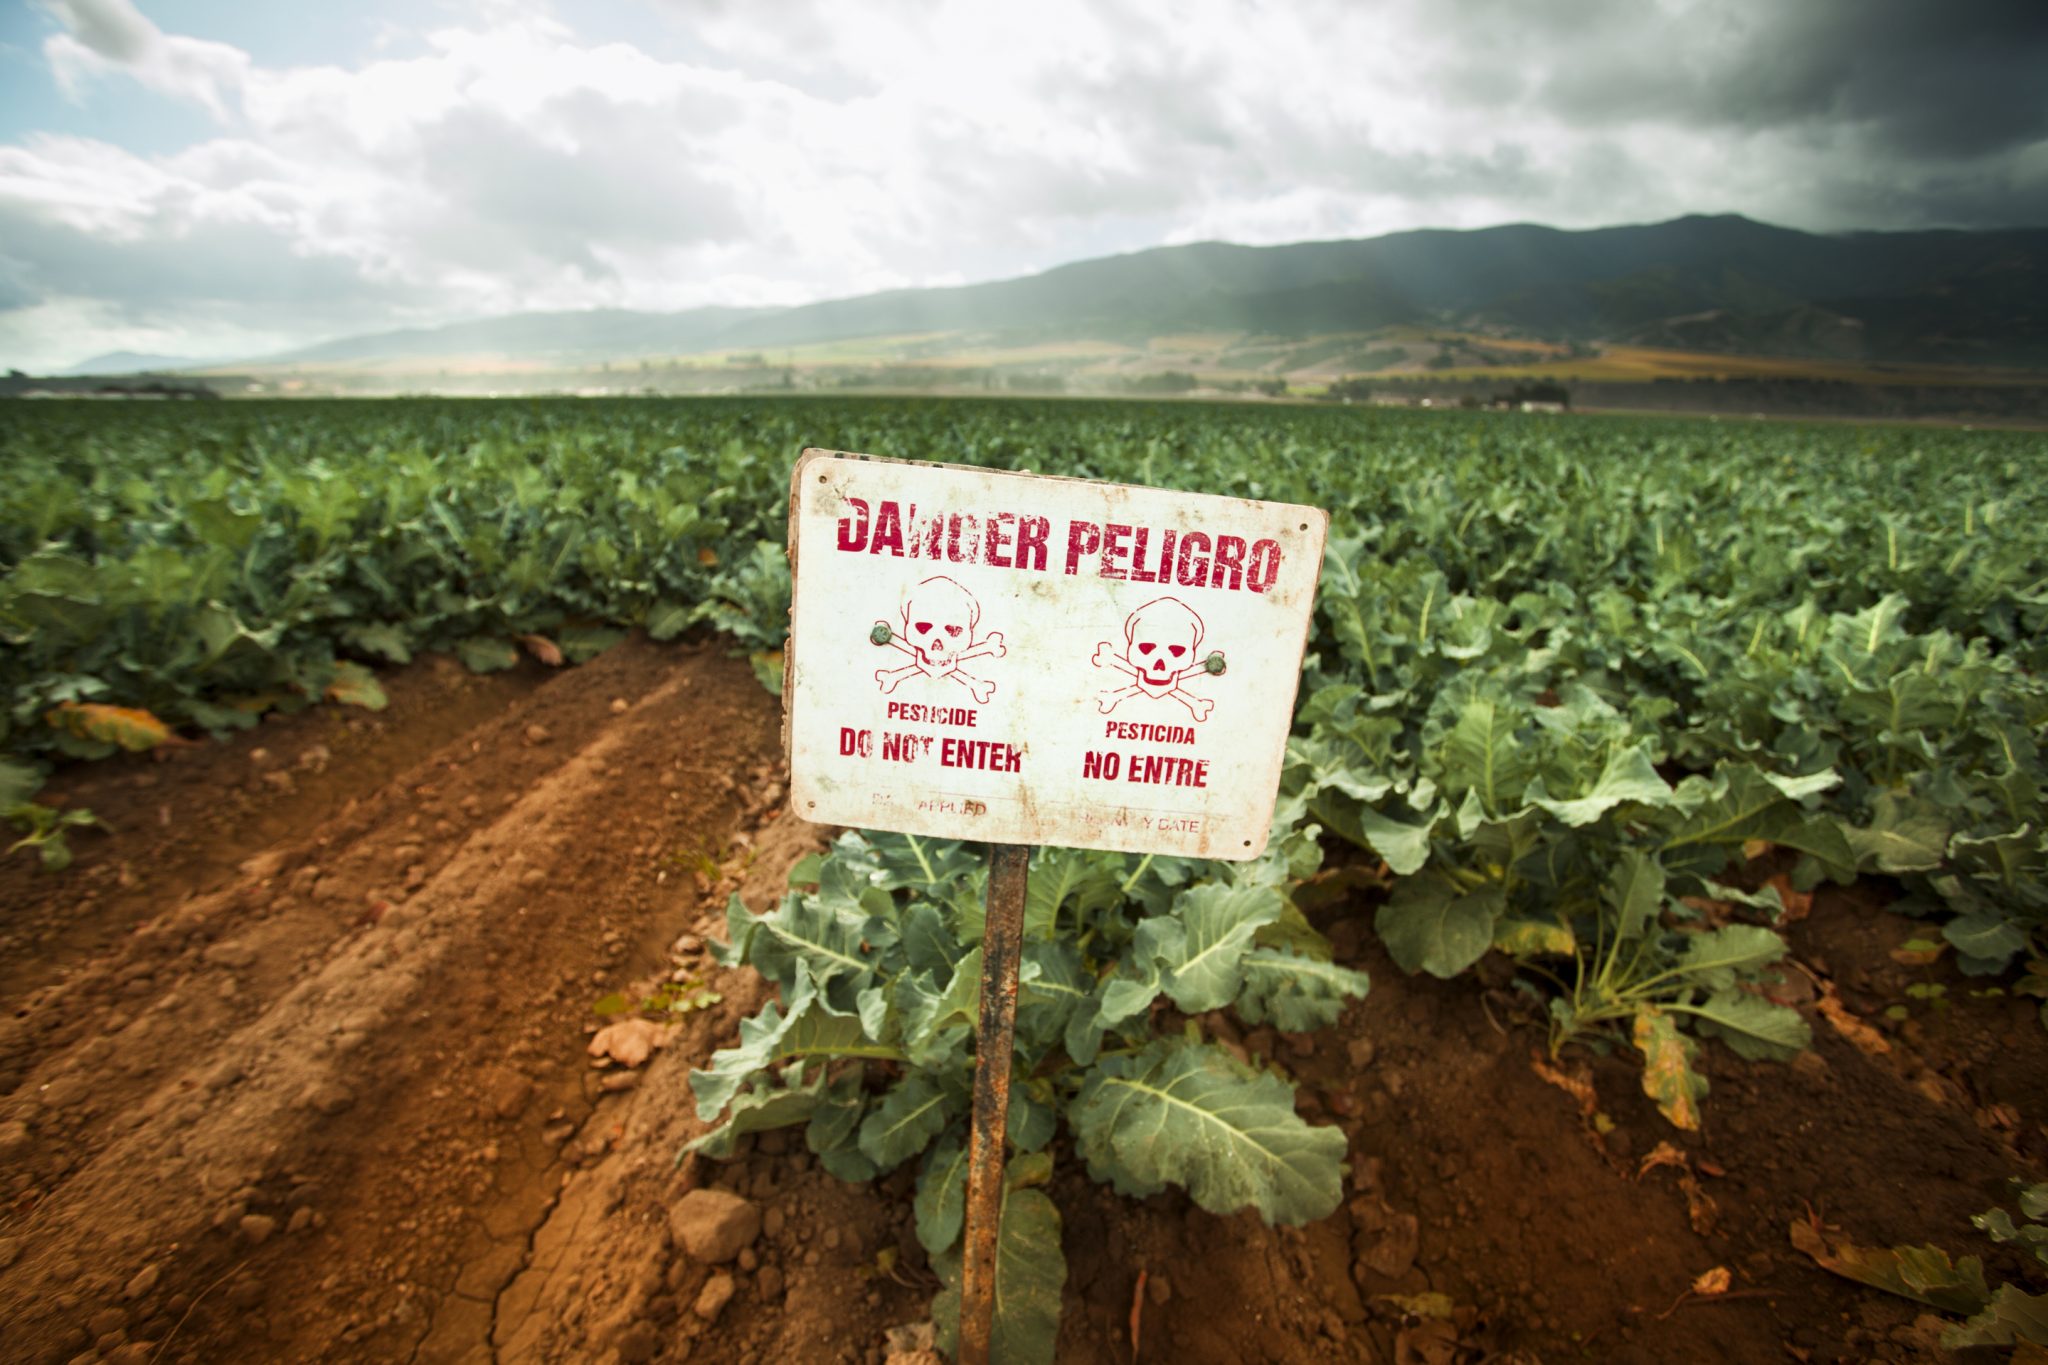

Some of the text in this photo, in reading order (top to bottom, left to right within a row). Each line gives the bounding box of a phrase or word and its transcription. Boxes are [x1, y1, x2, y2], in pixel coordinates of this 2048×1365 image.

[838, 497, 1281, 593] DANGER PELIGRO
[887, 701, 977, 727] PESTICIDE
[840, 727, 1022, 773] DO NOT ENTER
[1105, 721, 1195, 745] PESTICIDA
[1083, 751, 1209, 788] NO ENTRE
